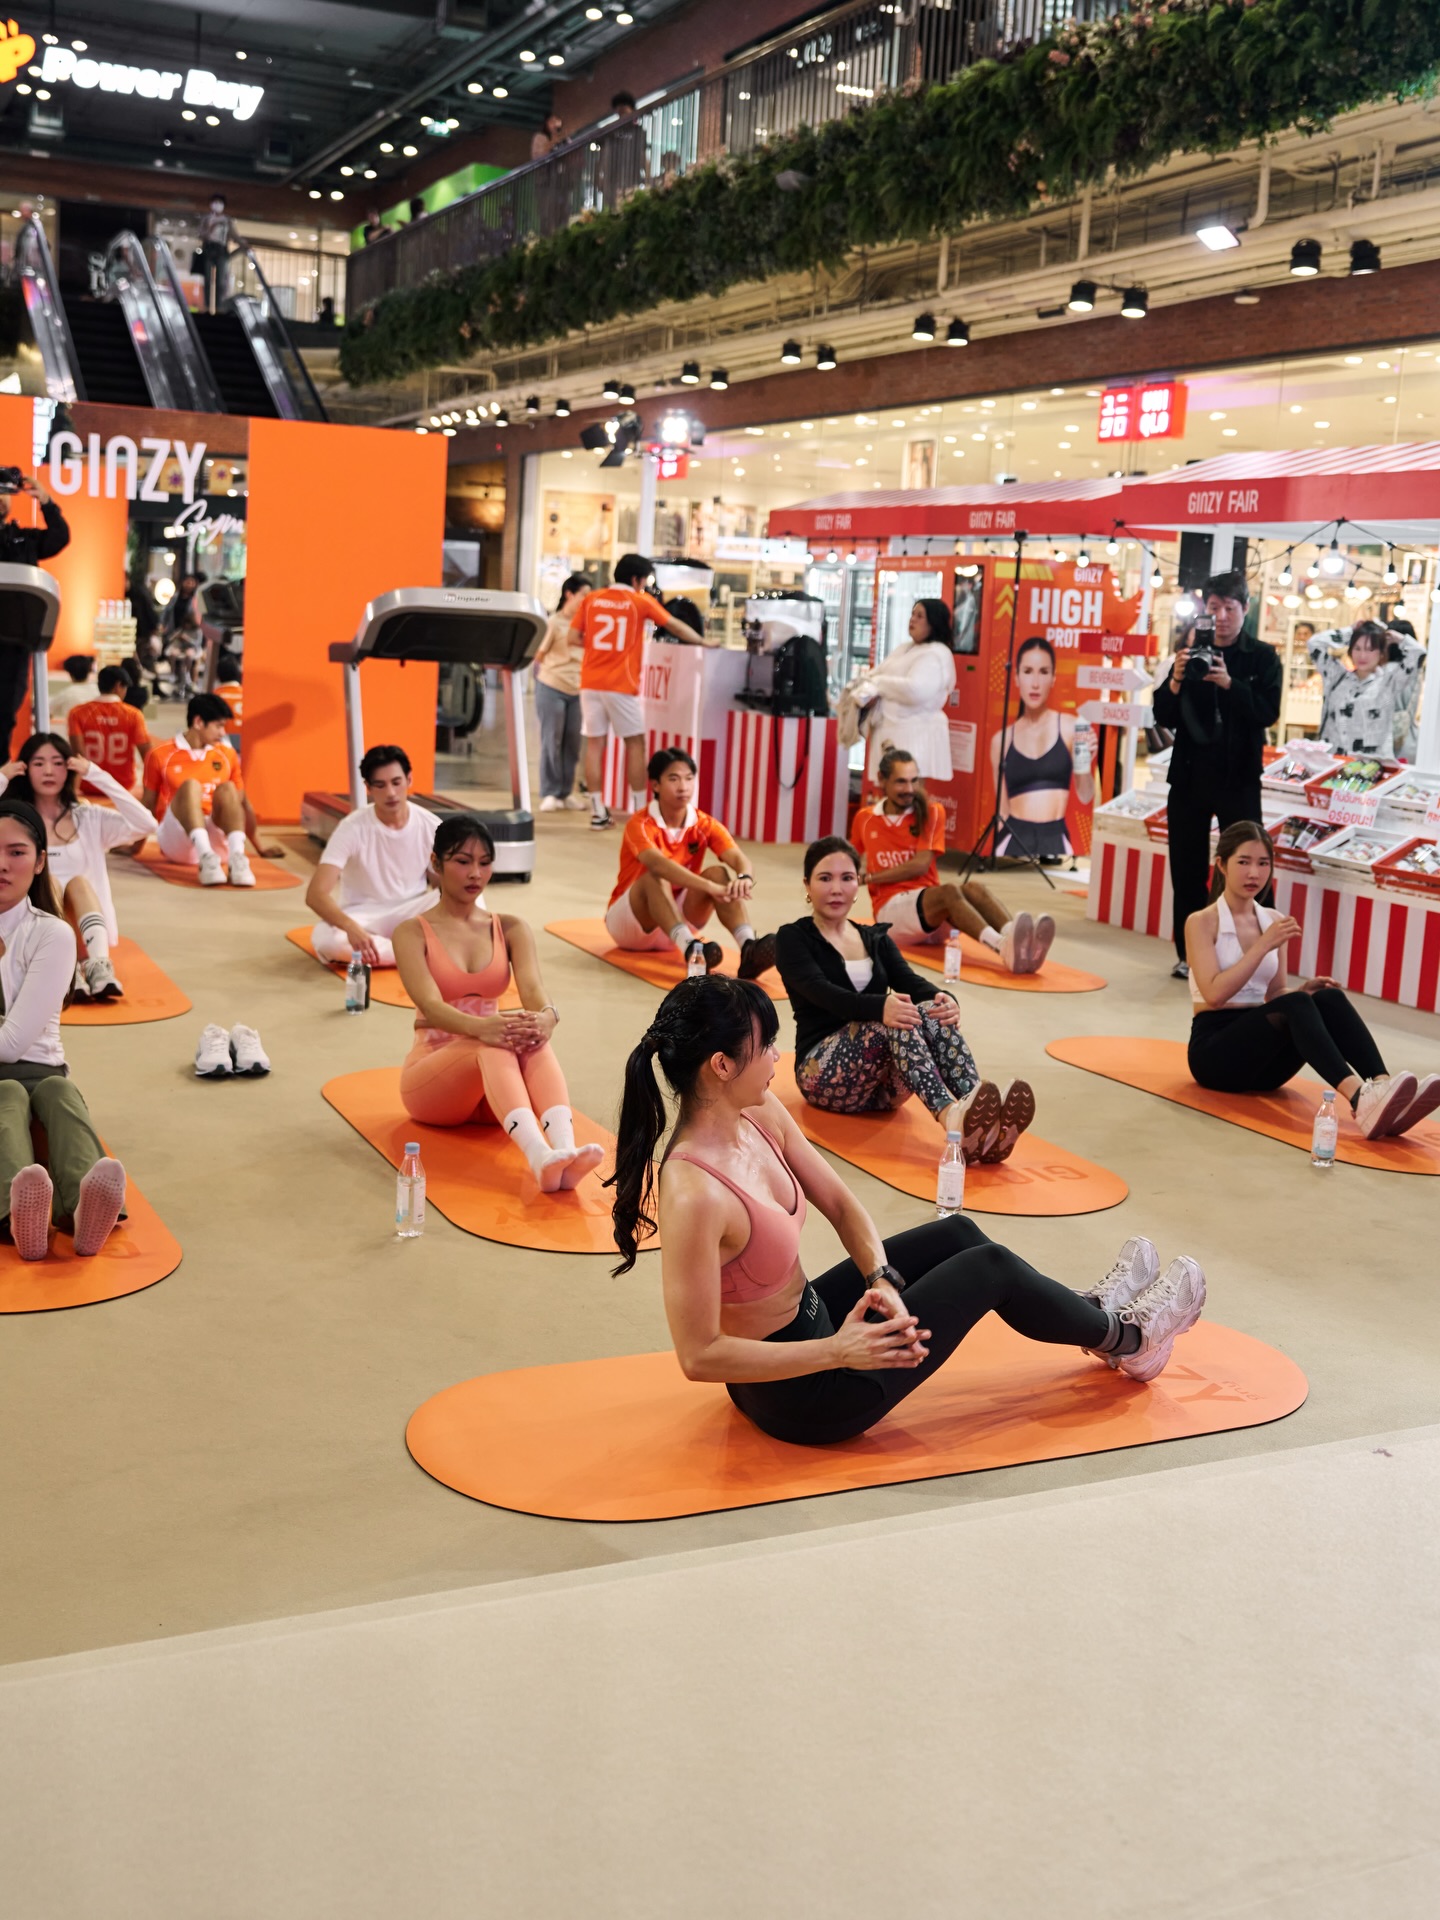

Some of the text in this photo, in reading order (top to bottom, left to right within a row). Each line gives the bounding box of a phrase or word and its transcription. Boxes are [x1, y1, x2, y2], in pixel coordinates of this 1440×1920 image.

[41, 46, 265, 121] Power Buy
[50, 430, 207, 505] GINZY
[1188, 489, 1259, 514] GINZY FAIR
[815, 514, 852, 530] GINZY FAIR
[969, 510, 1016, 528] GINZY FAIR
[1029, 587, 1104, 627] HIGH
[592, 614, 628, 652] 21
[1046, 627, 1102, 649] PROT
[1101, 636, 1124, 652] GINZY
[1089, 672, 1124, 685] BEVERAGE
[1103, 704, 1130, 721] SNACKS
